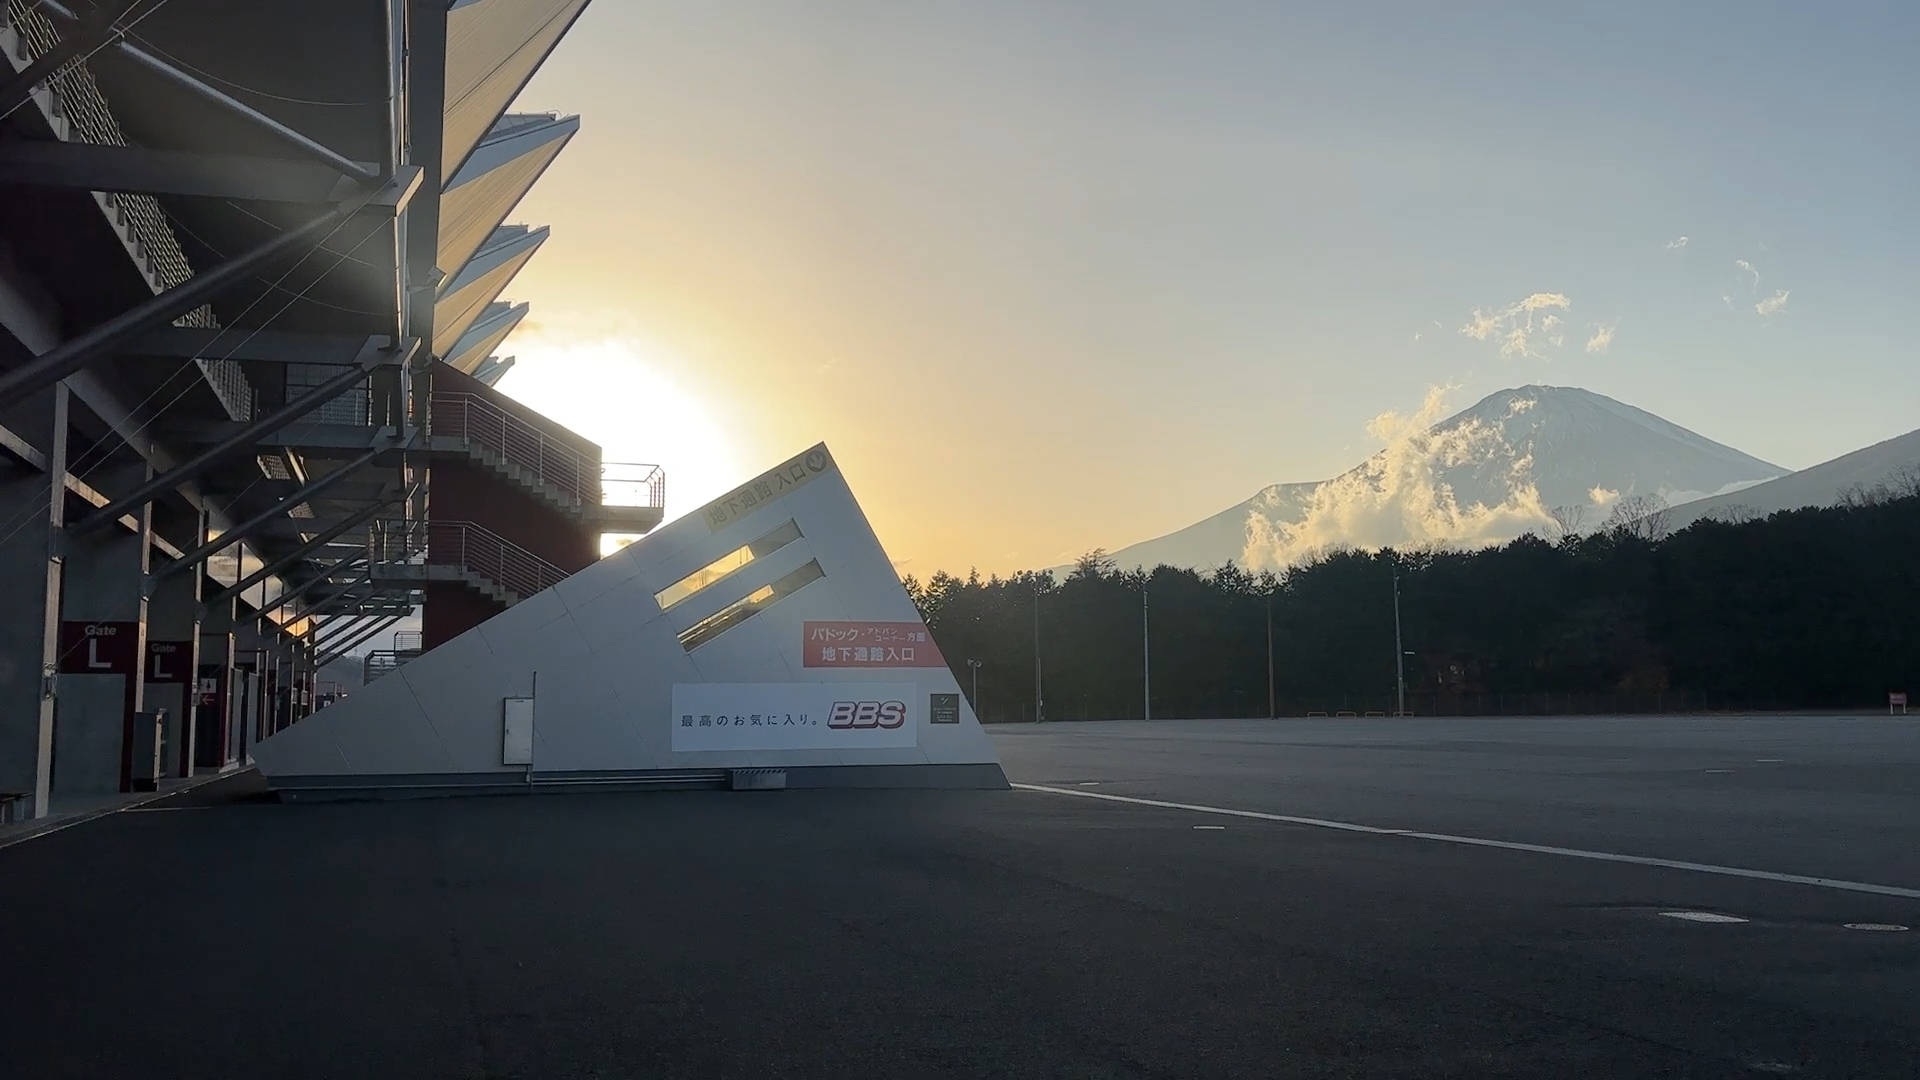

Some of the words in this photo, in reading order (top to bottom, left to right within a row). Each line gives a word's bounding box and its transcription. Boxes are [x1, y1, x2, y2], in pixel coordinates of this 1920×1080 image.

[84, 624, 117, 636] Gate
[88, 638, 112, 668] L
[151, 642, 177, 653] Gate
[822, 646, 916, 662] 地下通路入口
[154, 654, 173, 678] L
[827, 700, 906, 729] BBS
